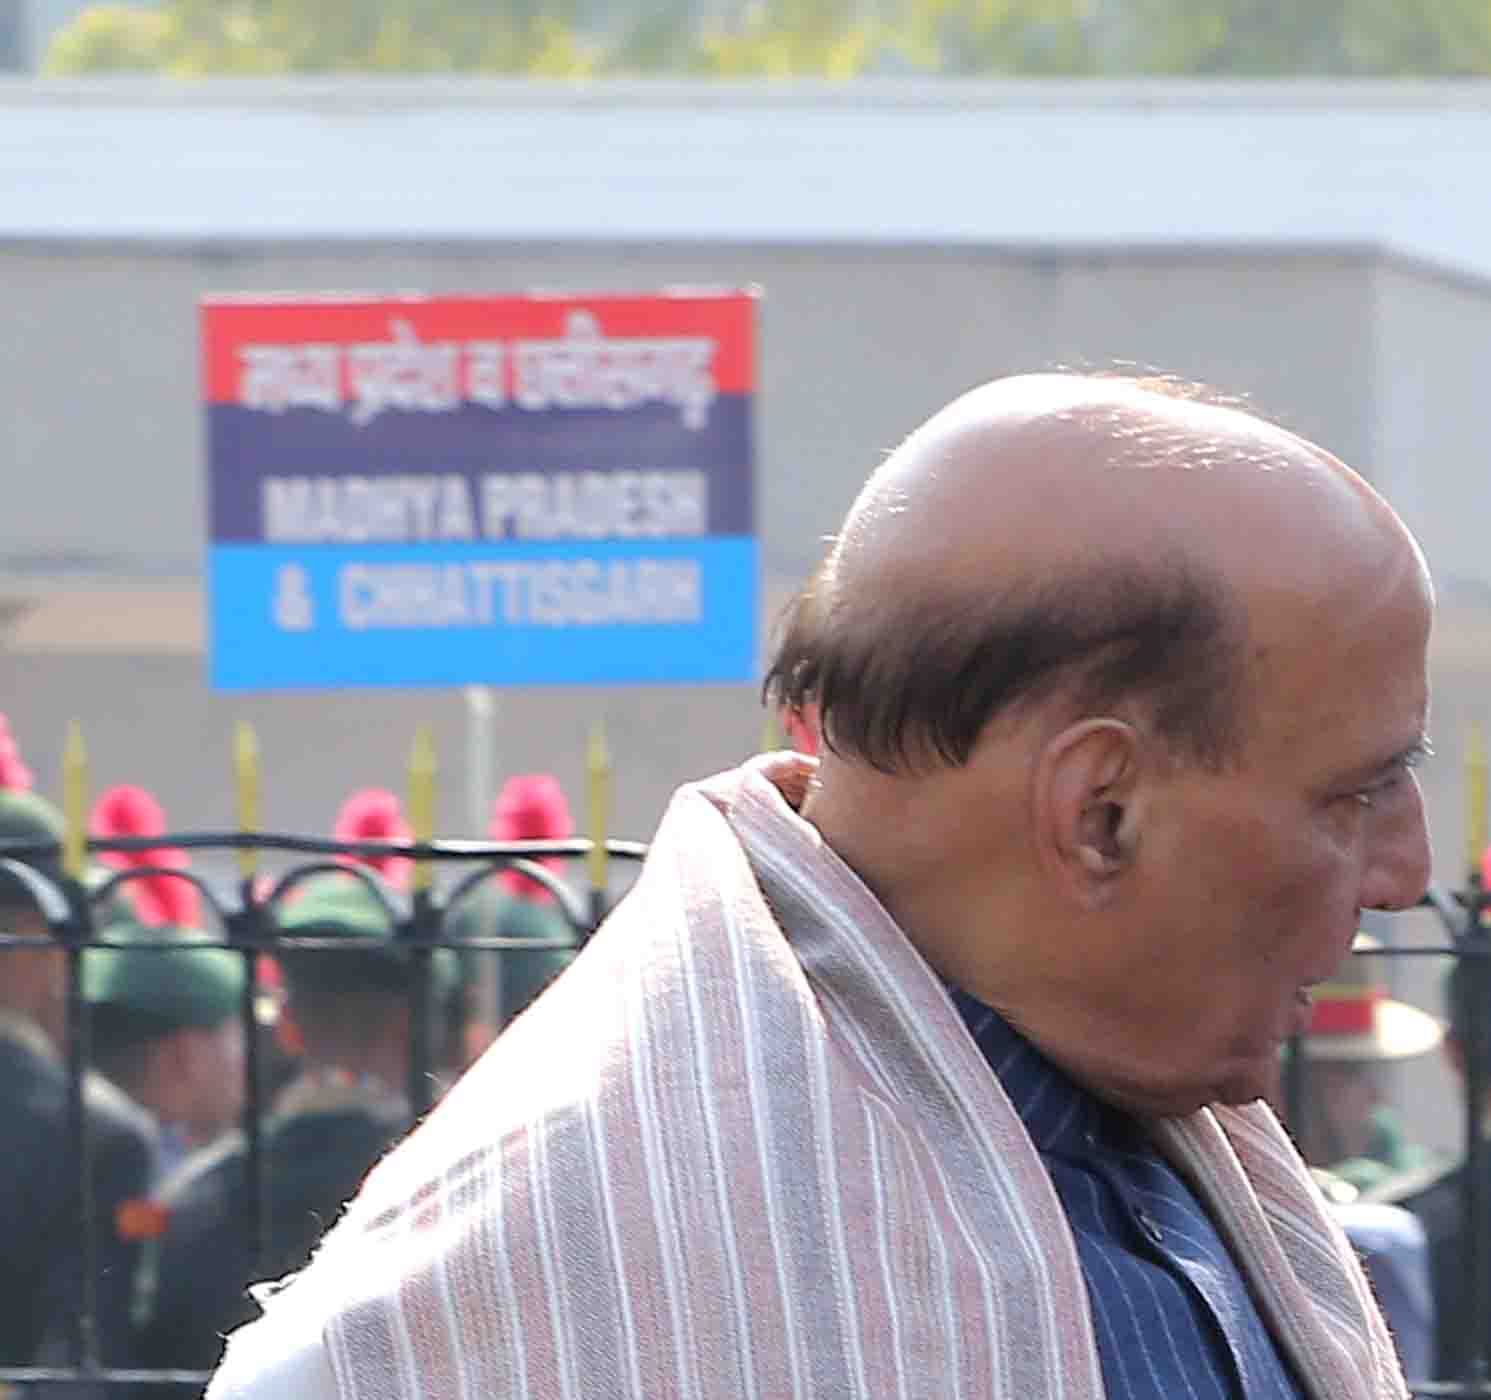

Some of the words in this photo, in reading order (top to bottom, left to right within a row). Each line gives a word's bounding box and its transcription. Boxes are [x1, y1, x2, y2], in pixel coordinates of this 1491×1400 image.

[264, 477, 472, 543] MADHYA
[482, 472, 705, 538] PRADESH
[275, 563, 312, 631] &
